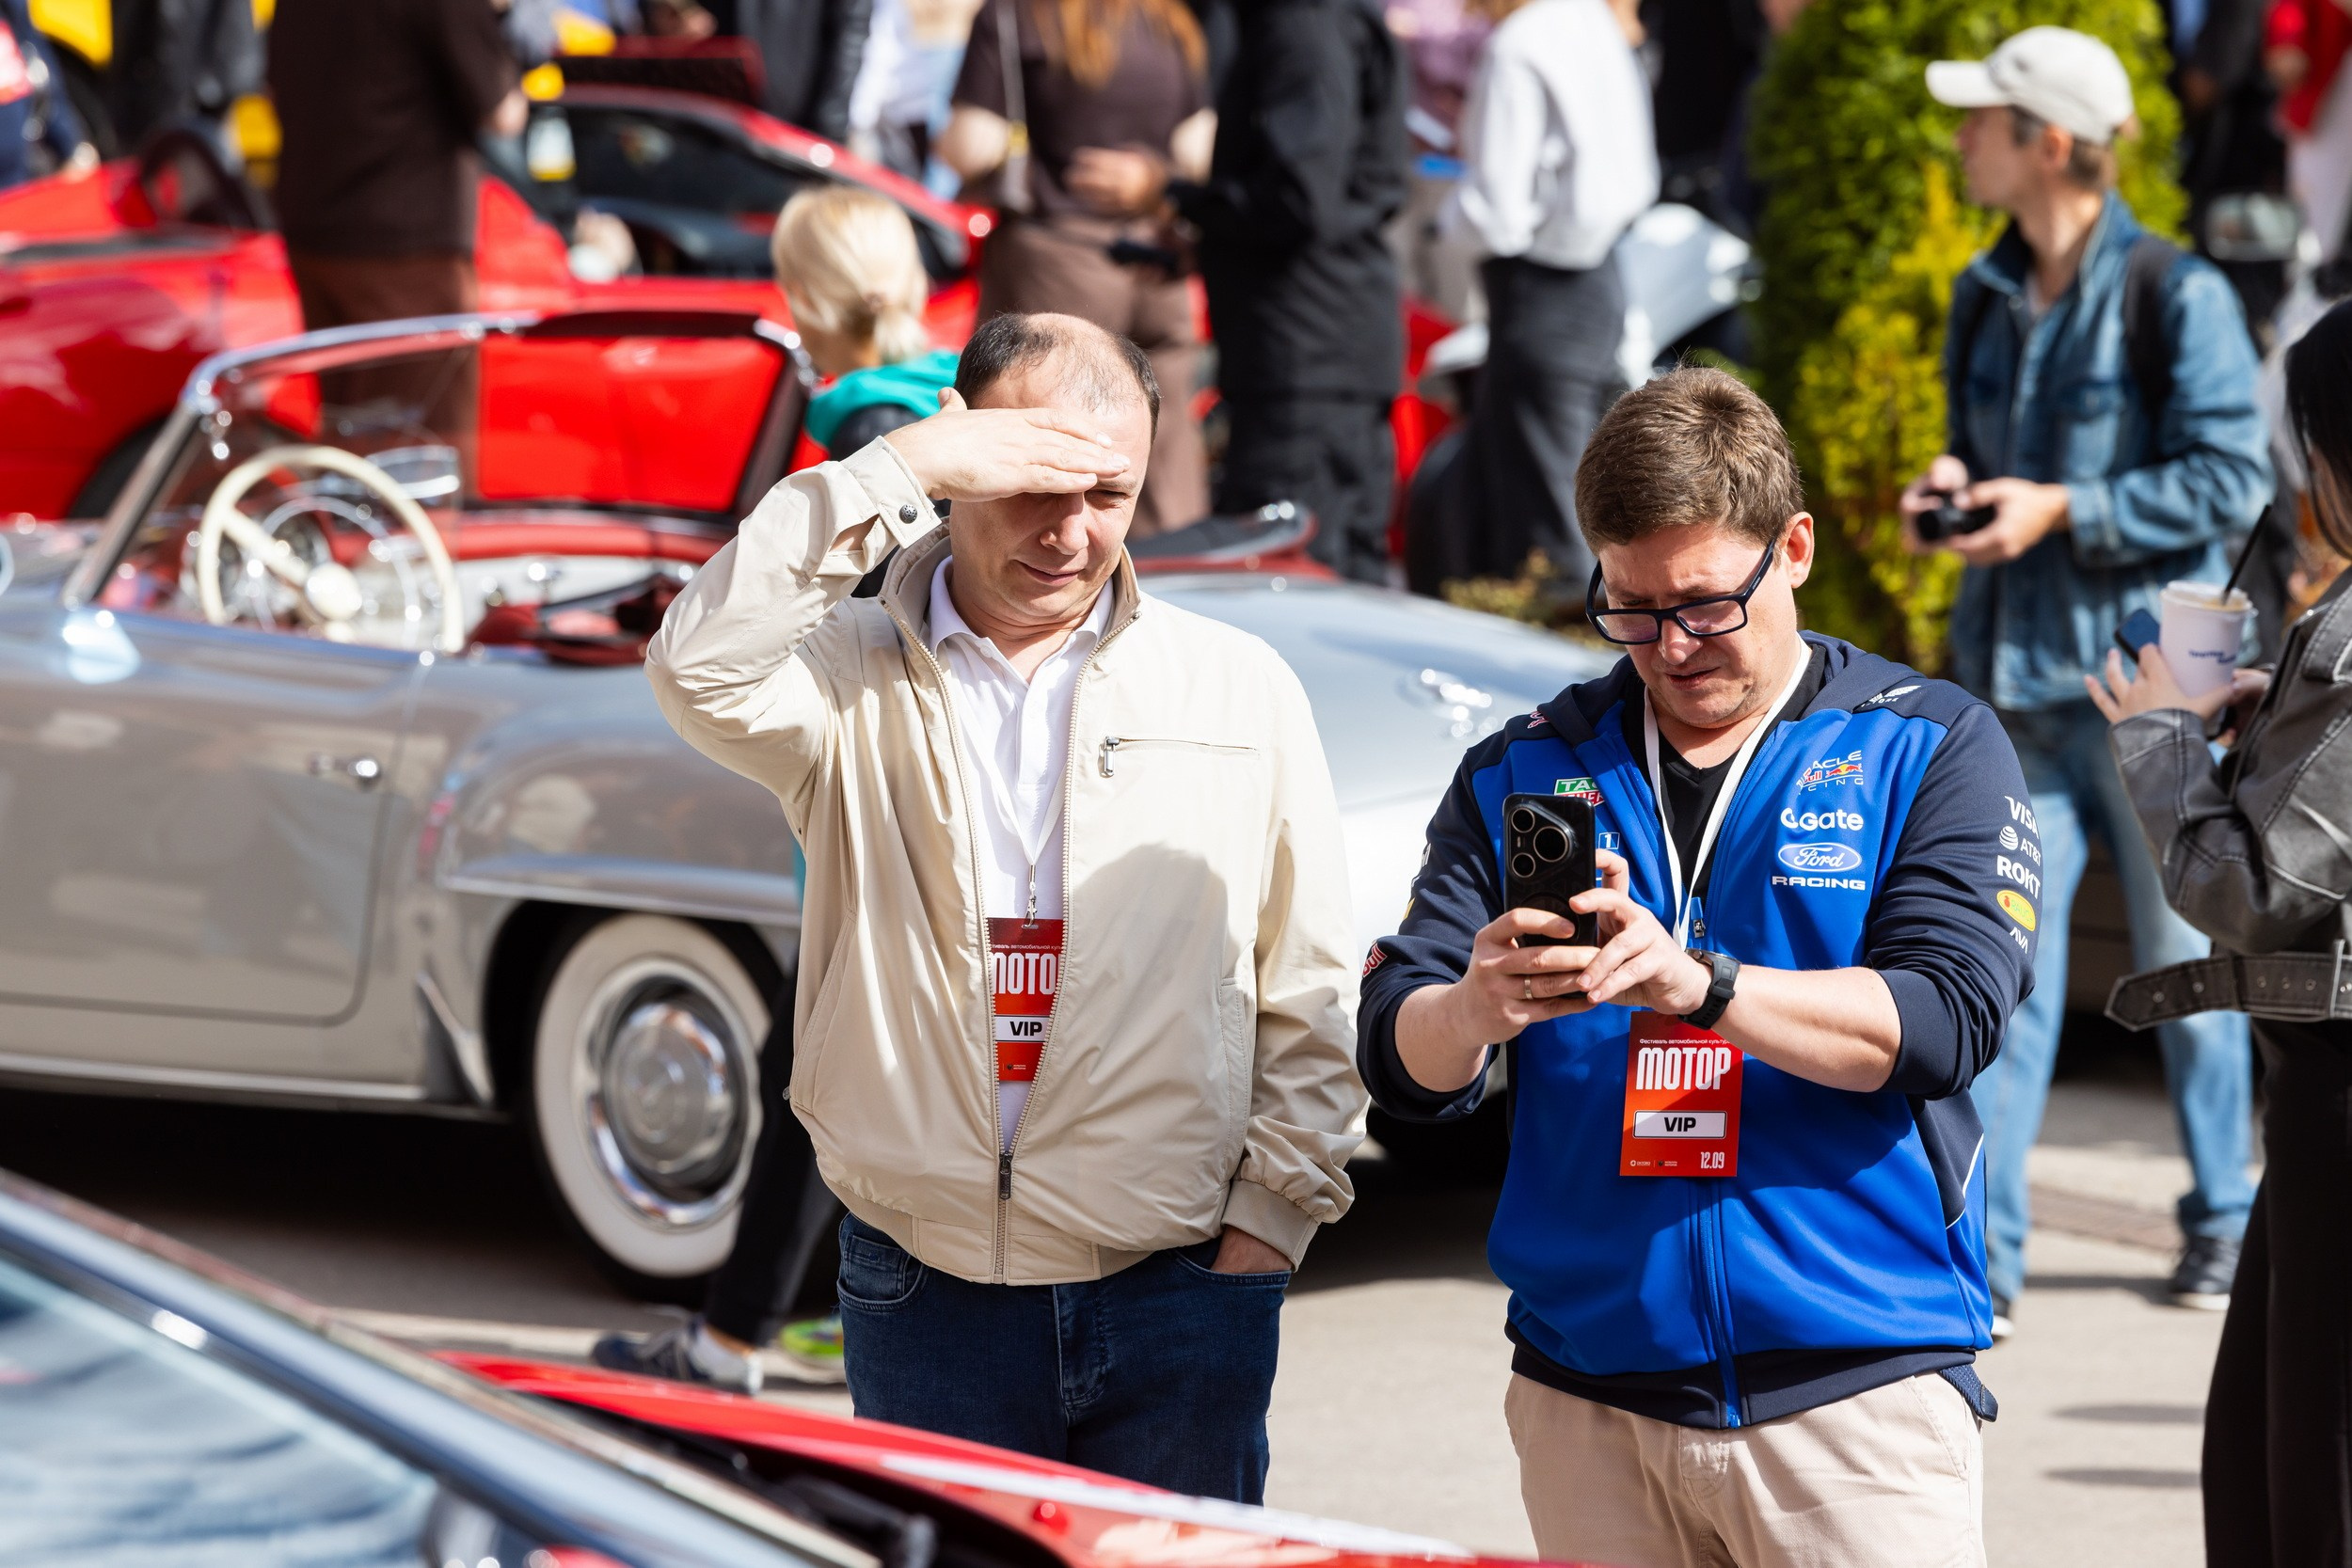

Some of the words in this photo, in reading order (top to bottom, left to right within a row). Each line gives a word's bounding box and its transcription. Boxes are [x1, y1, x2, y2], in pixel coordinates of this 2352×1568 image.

[2005, 796, 2039, 840] VISA
[1793, 847, 1846, 867] Ford
[2020, 837, 2041, 867] AT&T
[1772, 876, 1866, 891] RACING
[1996, 854, 2041, 899] ROKT
[1009, 1021, 1042, 1037] VIP
[1635, 1047, 1732, 1090] МОТОР
[1663, 1117, 1697, 1132] VIP
[1700, 1151, 1725, 1169] 12.09
